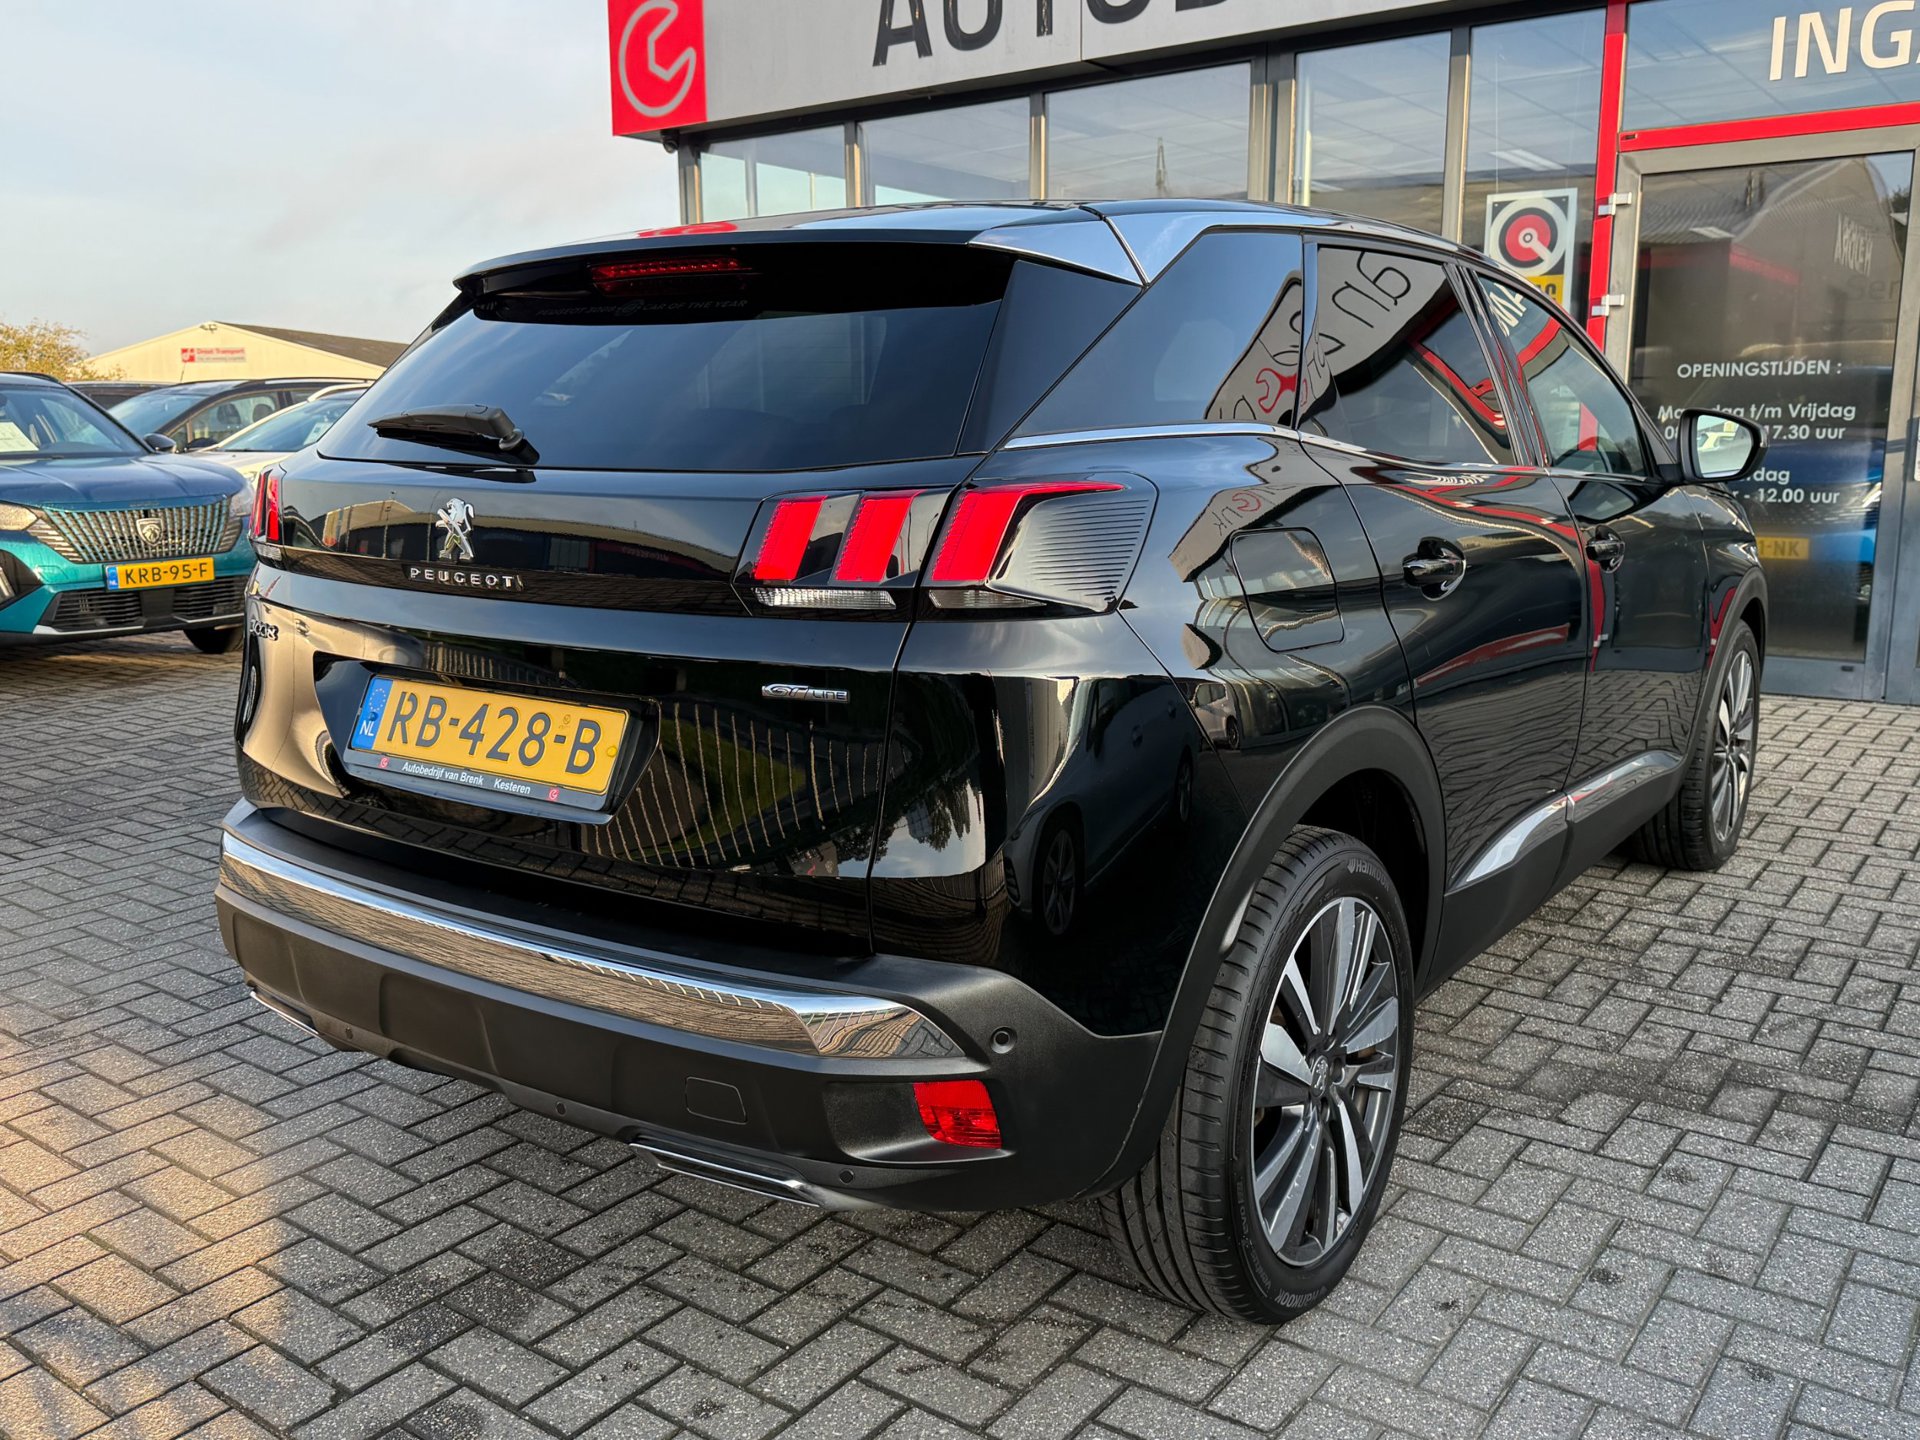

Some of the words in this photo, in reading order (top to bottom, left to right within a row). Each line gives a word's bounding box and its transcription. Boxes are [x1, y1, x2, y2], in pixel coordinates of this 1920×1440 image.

[1769, 0, 1920, 81] ING
[1677, 360, 1830, 378] OPENINGSTIJDEN
[1750, 403, 1781, 419] t/m
[1788, 402, 1856, 421] Vrijdag
[1815, 427, 1846, 439] uur
[1758, 488, 1804, 503] 12.00
[1810, 491, 1840, 503] uur
[125, 563, 208, 585] KRB-95-F
[410, 567, 514, 588] PEUGEOT
[359, 720, 375, 737] NL
[387, 691, 602, 775] RB-428-B
[402, 761, 444, 780] Autobedrijf
[444, 771, 459, 782] van
[460, 773, 484, 786] Brenk
[493, 778, 532, 795] Kesteren
